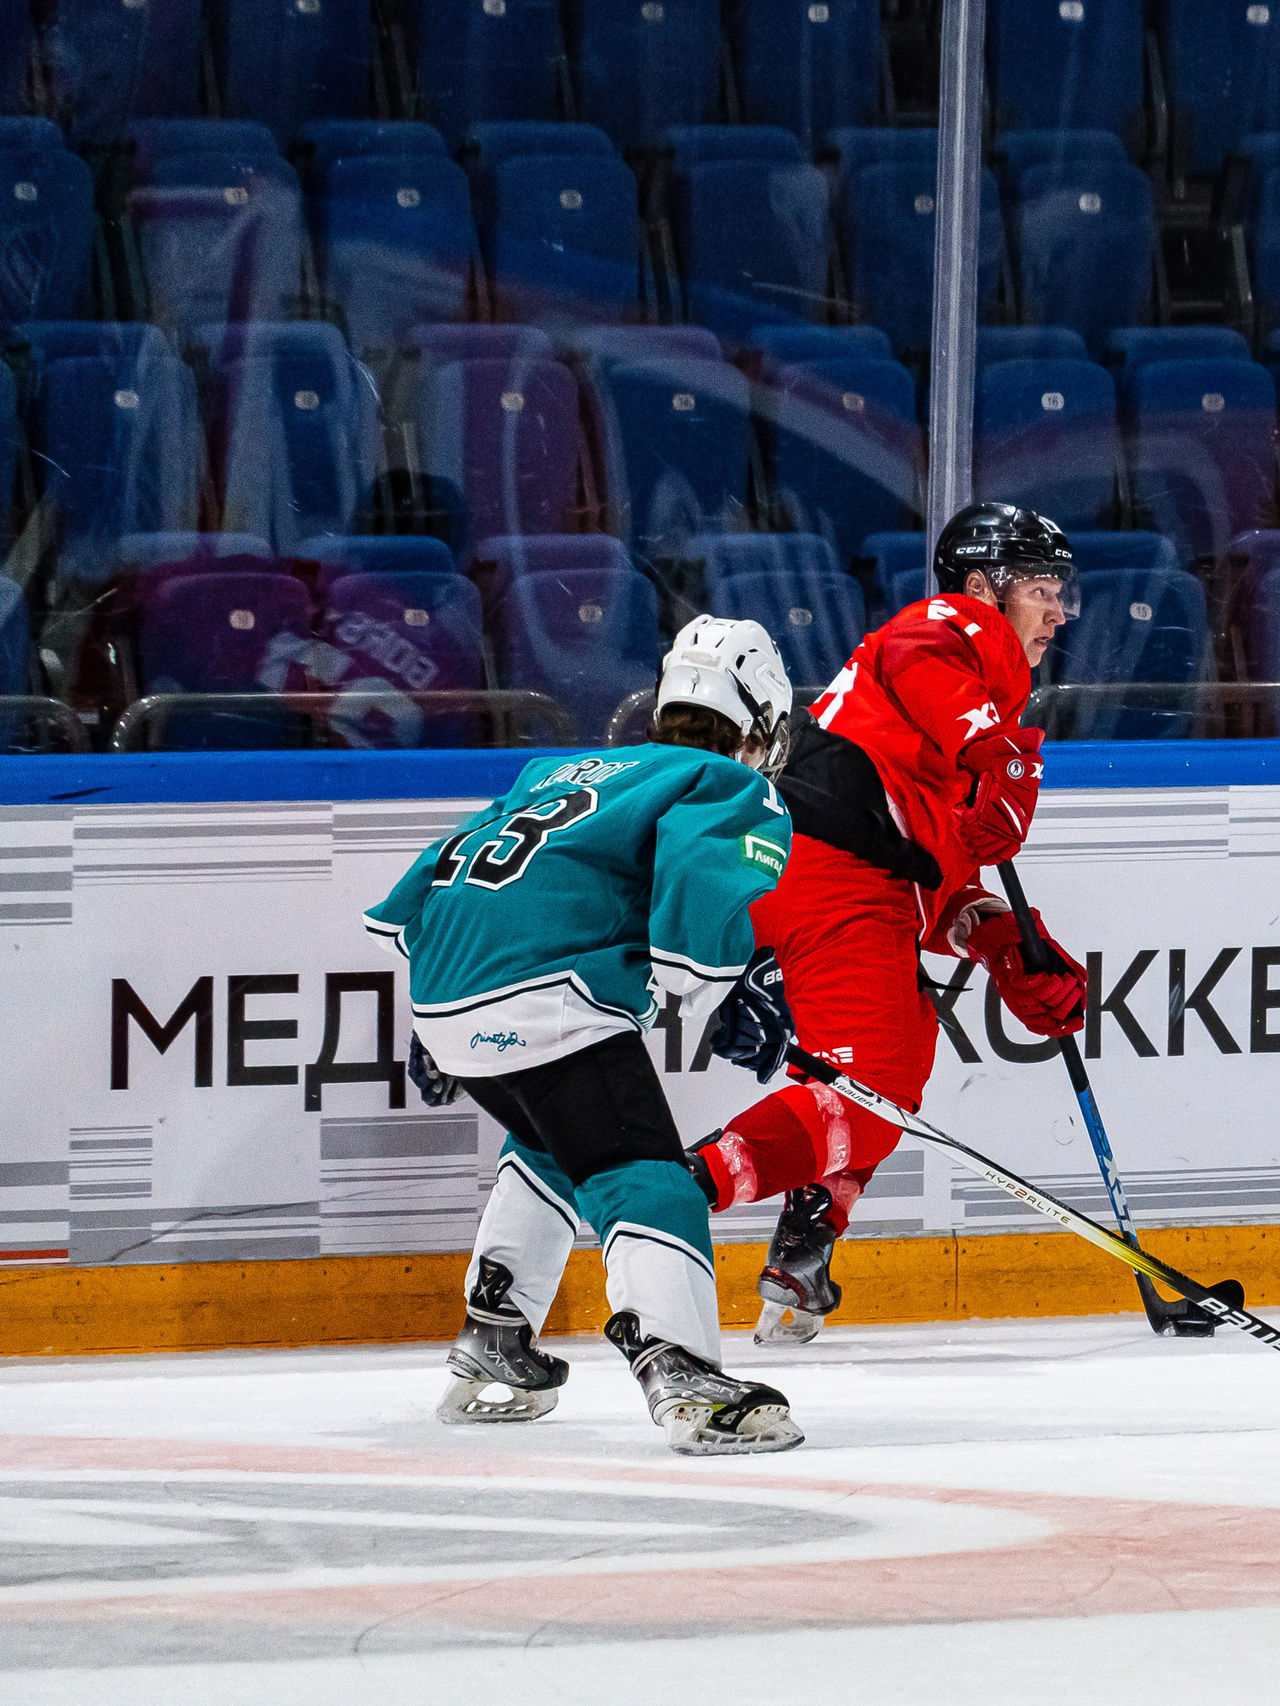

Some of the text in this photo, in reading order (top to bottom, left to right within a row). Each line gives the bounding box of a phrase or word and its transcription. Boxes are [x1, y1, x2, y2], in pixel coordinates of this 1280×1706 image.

[956, 545, 988, 555] CCM
[1054, 548, 1074, 560] CCM
[431, 786, 599, 891] 13
